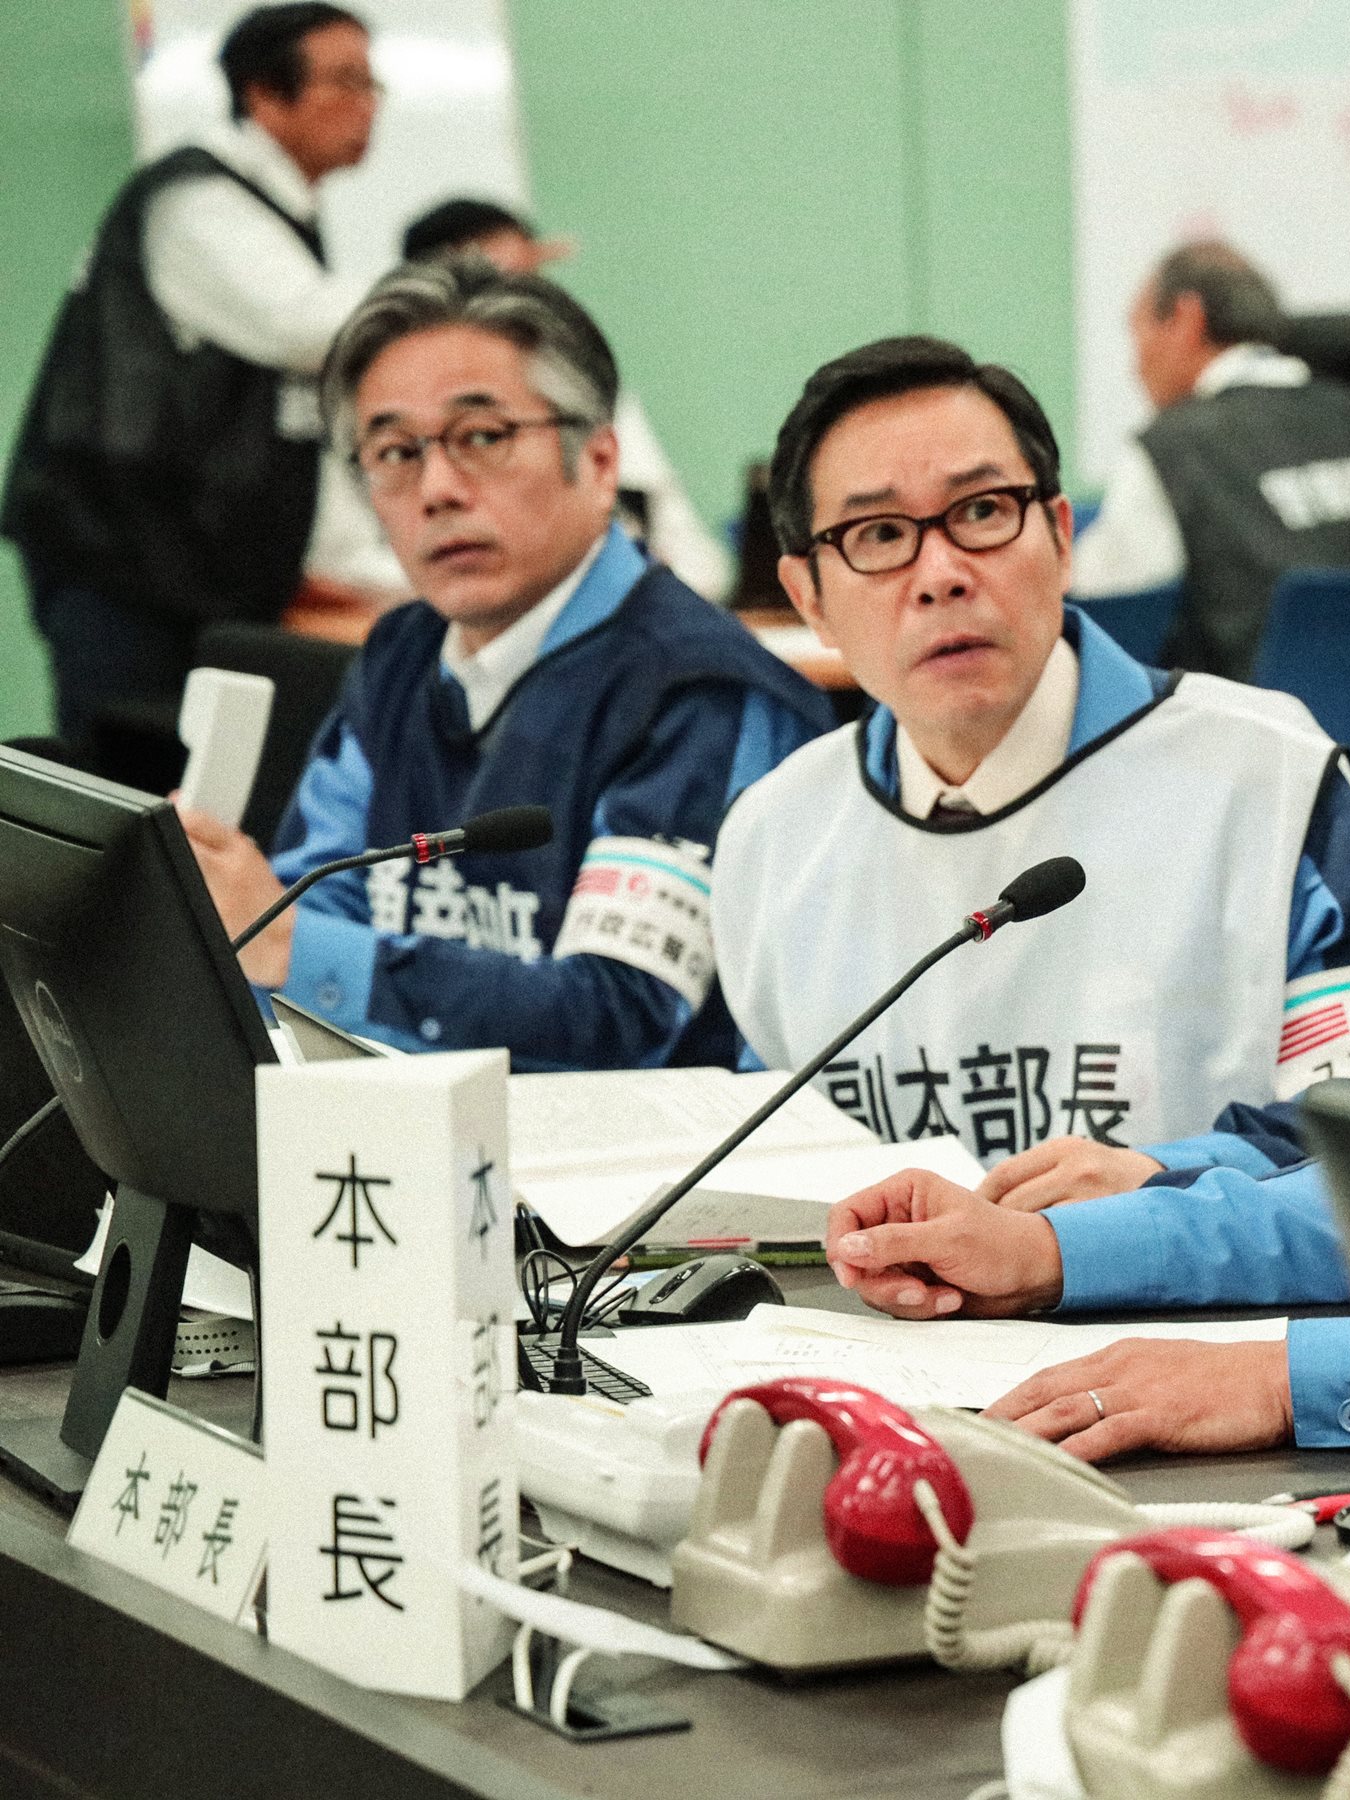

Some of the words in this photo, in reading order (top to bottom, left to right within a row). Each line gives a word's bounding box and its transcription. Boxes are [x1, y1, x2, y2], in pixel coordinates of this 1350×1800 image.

[822, 1043, 1131, 1157] 副本部長
[313, 1152, 407, 1613] 本部長
[111, 1449, 240, 1587] 本部長
